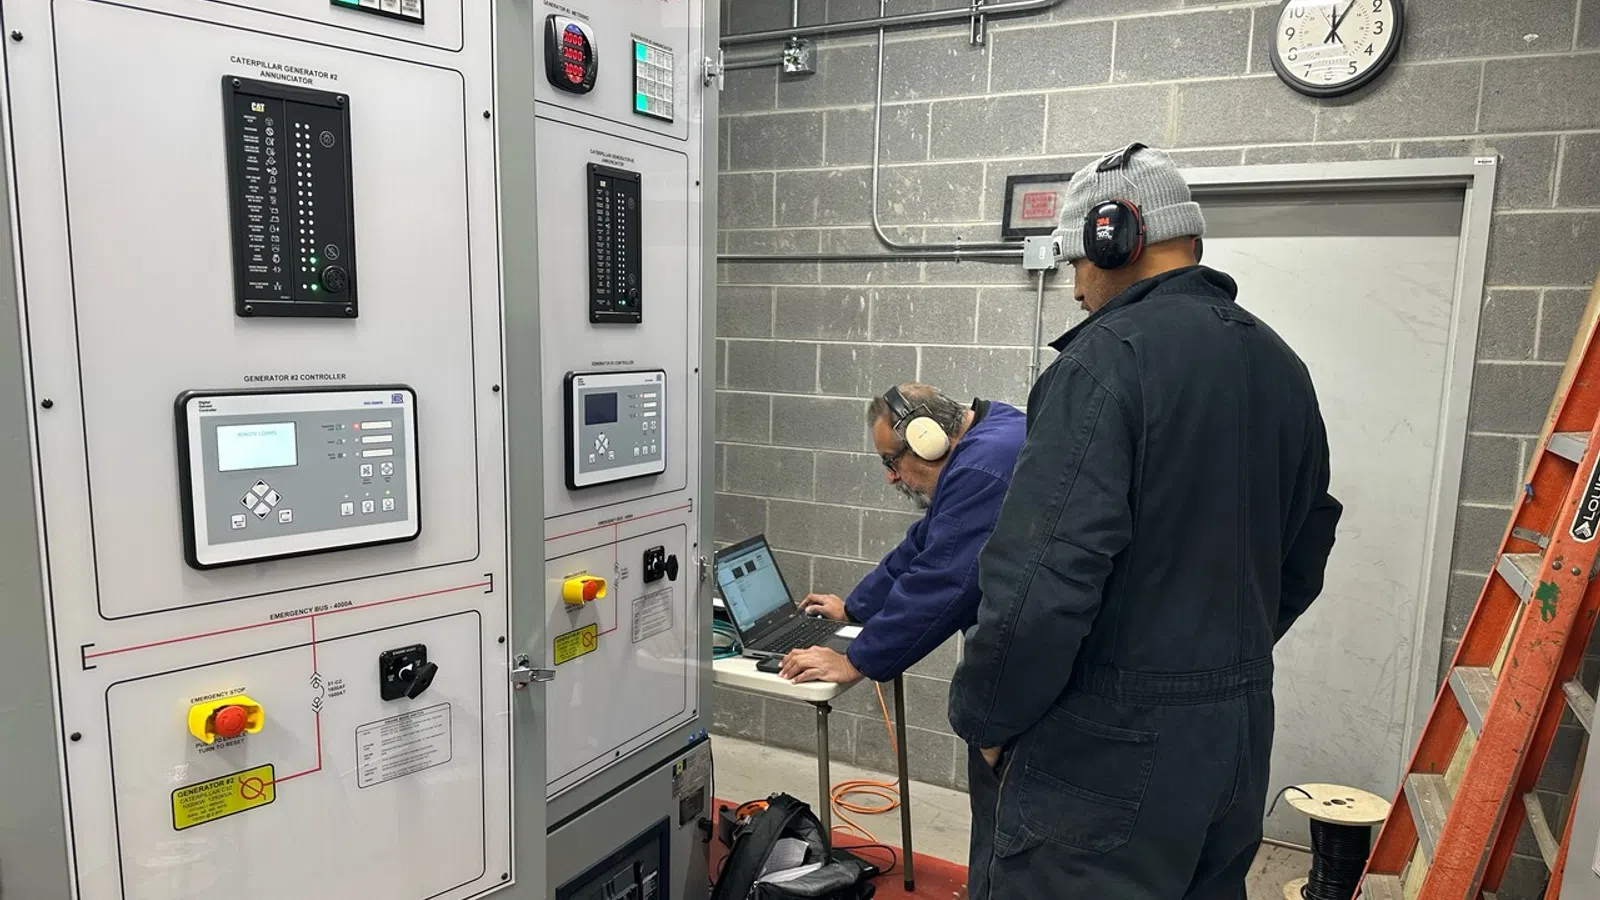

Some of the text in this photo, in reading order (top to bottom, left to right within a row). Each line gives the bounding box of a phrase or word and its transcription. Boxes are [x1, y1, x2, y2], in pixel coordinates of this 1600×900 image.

[1372, 0, 1383, 12] 2
[1285, 27, 1295, 41] 9
[1373, 20, 1384, 35] 3
[1364, 43, 1374, 56] 4
[230, 55, 283, 71] CATERPILLAR
[284, 65, 329, 79] GENERATOR
[1303, 64, 1312, 77] 7
[1348, 61, 1357, 75] 5
[260, 70, 313, 85] ANNUNCIATOR
[251, 102, 265, 112] CAT
[243, 374, 290, 382] GENERATOR
[270, 607, 313, 620] EMERGENCY
[333, 600, 353, 608] 4000A
[191, 687, 246, 703] EMERGENCY STOP
[226, 738, 244, 747] RESET
[177, 777, 235, 798] GENERATOR #2
